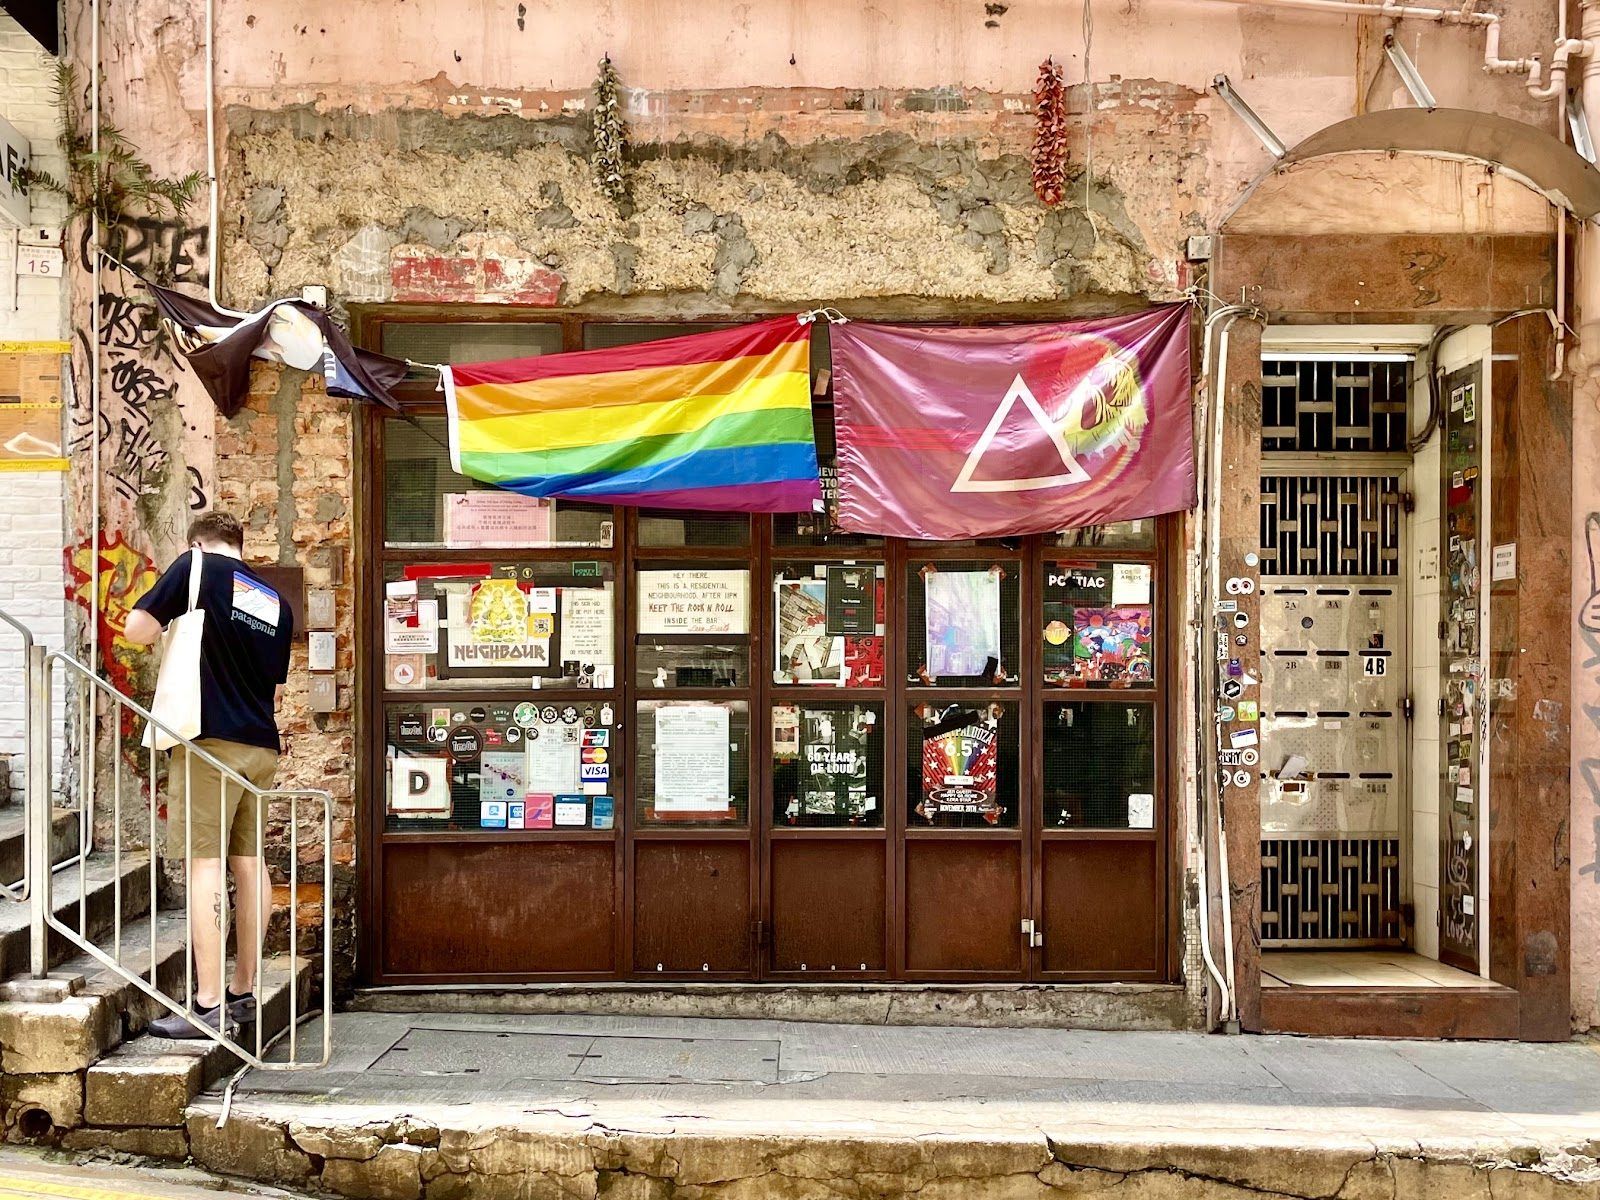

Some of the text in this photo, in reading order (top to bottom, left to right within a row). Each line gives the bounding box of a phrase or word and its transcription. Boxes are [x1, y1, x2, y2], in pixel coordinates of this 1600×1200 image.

[28, 260, 50, 274] 15
[1048, 575, 1105, 589] POTIAC
[648, 603, 734, 613] KEEP THE ROCK N ROLL
[1284, 601, 1297, 609] 2A
[1327, 601, 1339, 609] 3A
[230, 609, 277, 637] patagonia
[1285, 661, 1297, 669] 2B
[1327, 661, 1340, 669] 3B
[1365, 658, 1385, 675] 4B
[945, 740, 973, 757] 6.5
[807, 752, 857, 762] 60 YEARS
[585, 766, 608, 775] VISA
[811, 763, 854, 774] OF LOUD
[408, 769, 431, 796] D
